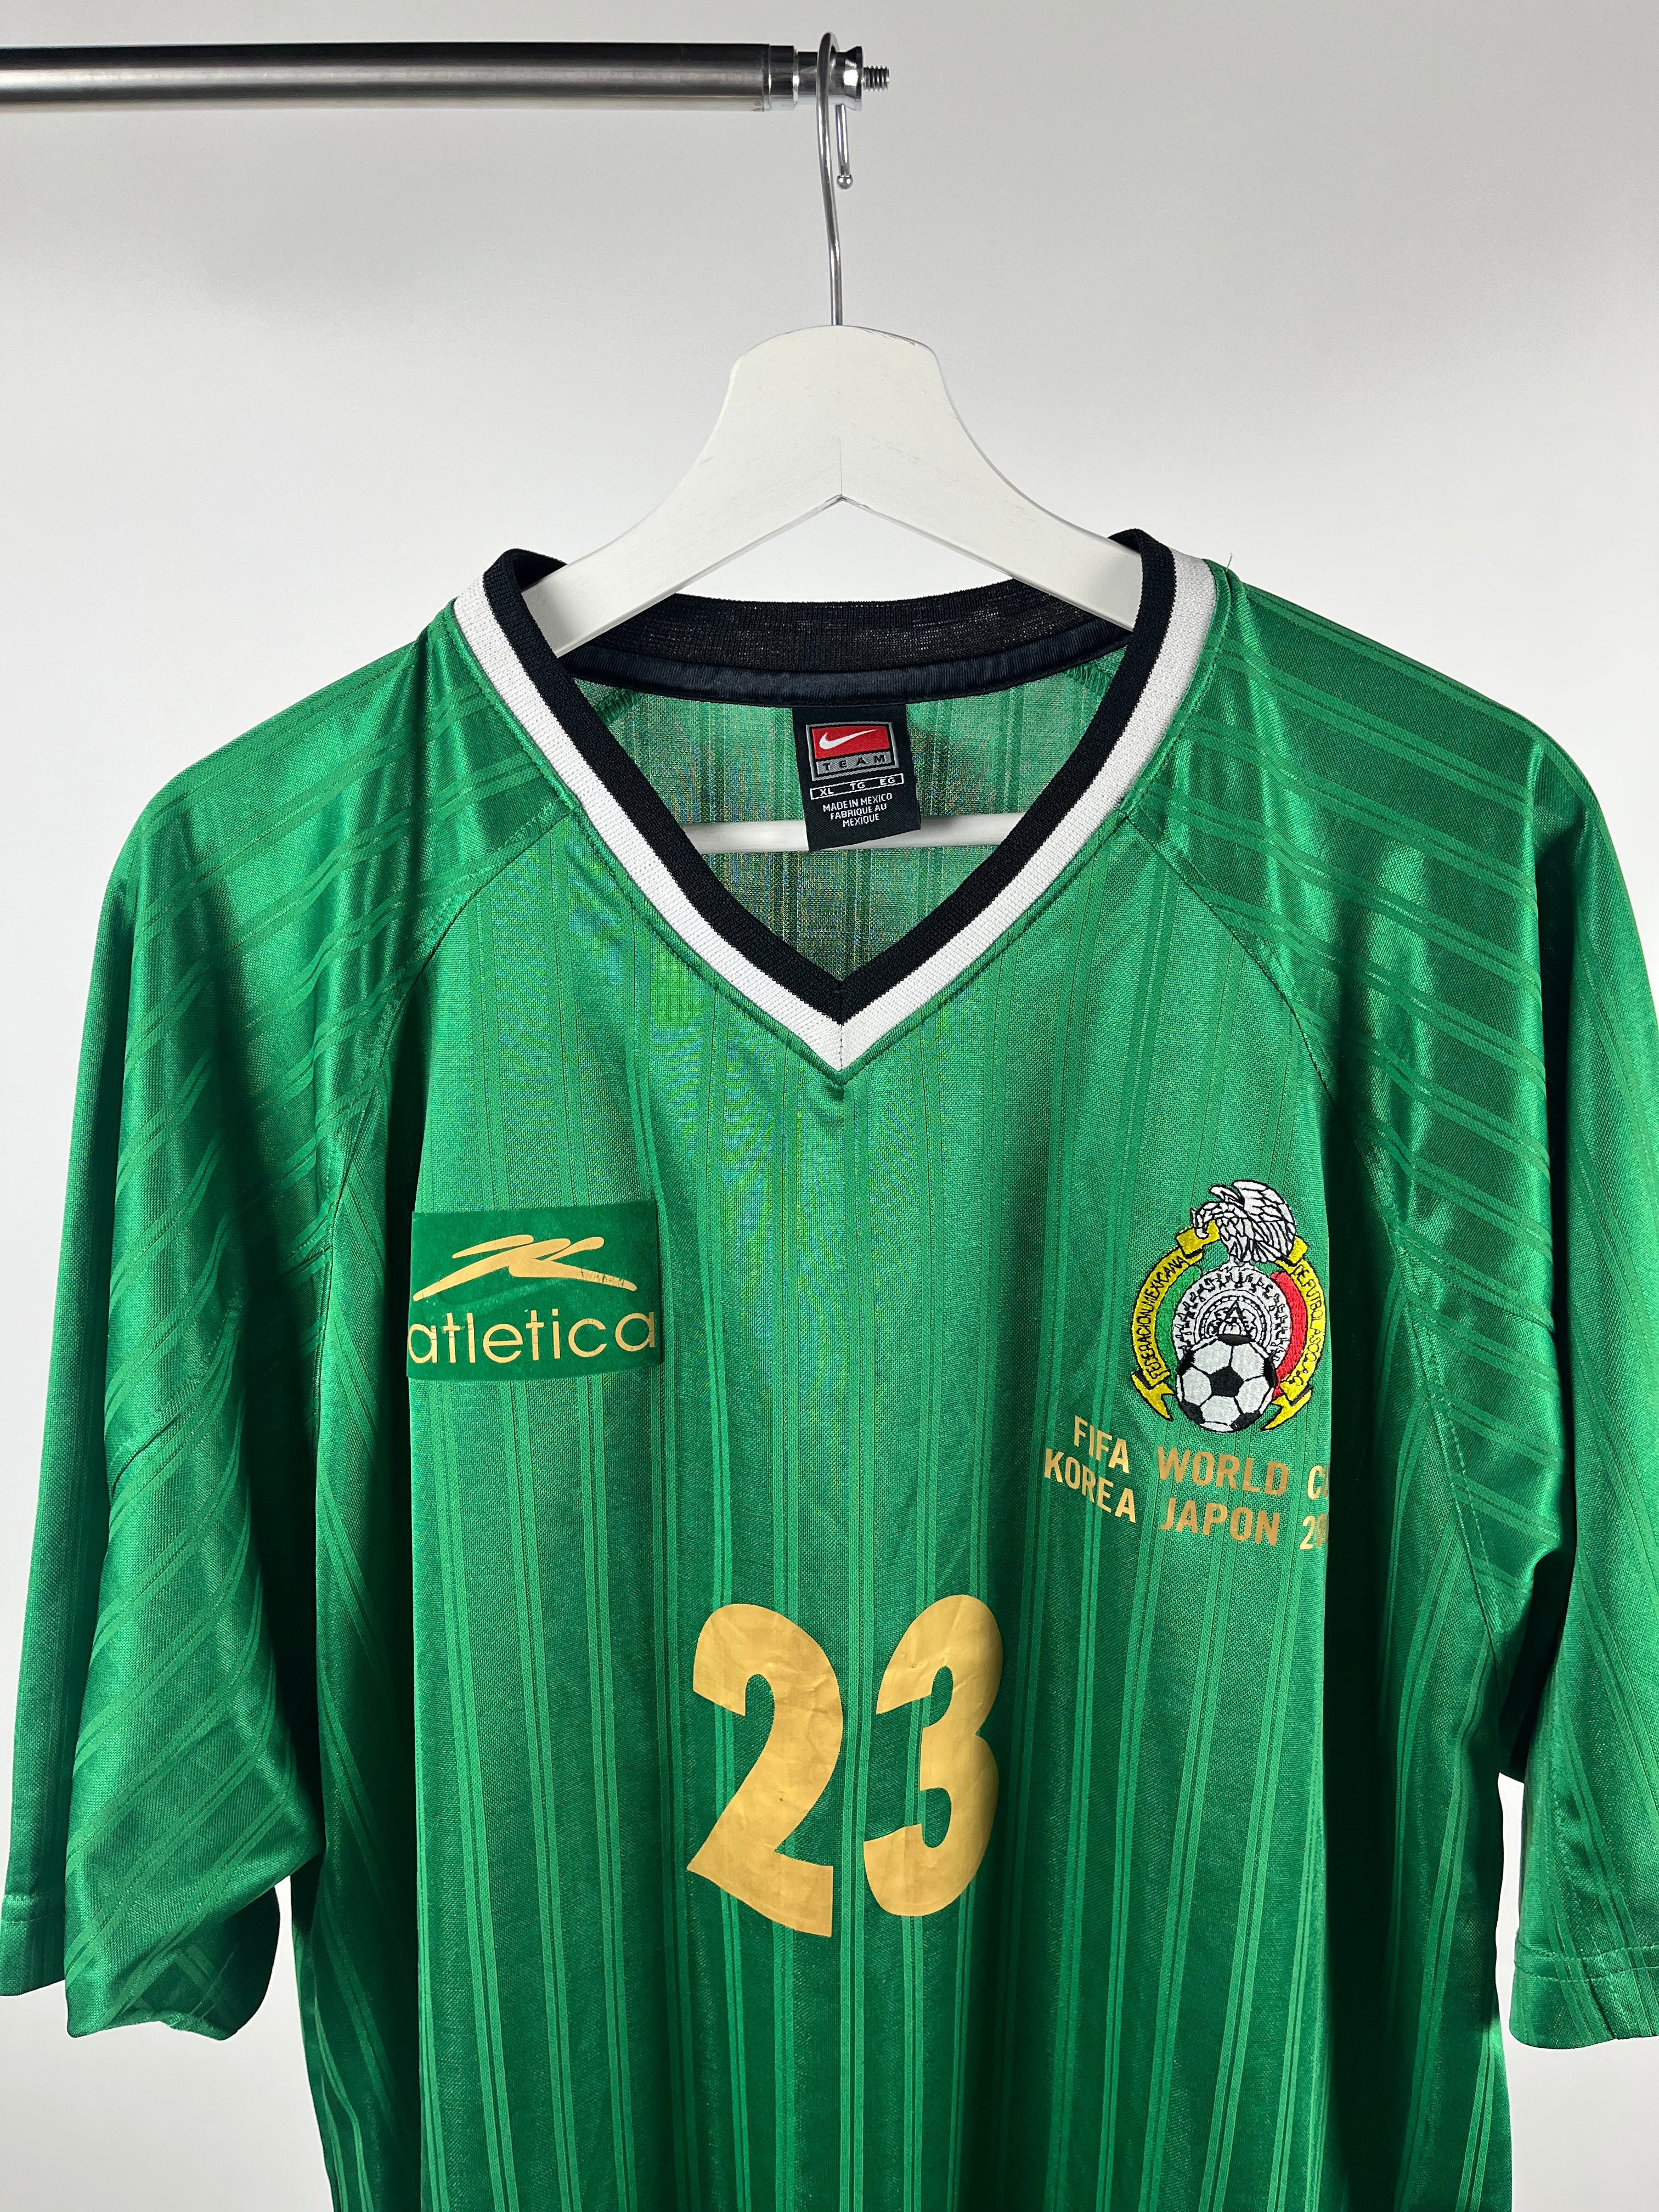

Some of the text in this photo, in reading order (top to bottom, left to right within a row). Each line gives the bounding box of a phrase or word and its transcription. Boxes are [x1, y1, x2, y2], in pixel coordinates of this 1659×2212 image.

[823, 754, 886, 771] TEAM
[819, 777, 895, 797] XL TG EG
[822, 793, 893, 812] MADE IN MEXICO
[830, 804, 887, 820] FABRIQUE AU
[843, 813, 879, 827] MEXIQUE
[1293, 1263, 1310, 1286] DE
[1136, 1255, 1189, 1379] FEDERACION MEXICANA
[408, 1308, 656, 1364] atletica
[1074, 1415, 1130, 1474] FIFA
[1157, 1446, 1289, 1496] WORLD
[1044, 1448, 1136, 1523] KOREA
[1160, 1498, 1281, 1547] JAPON
[687, 1594, 1003, 1937] 23
